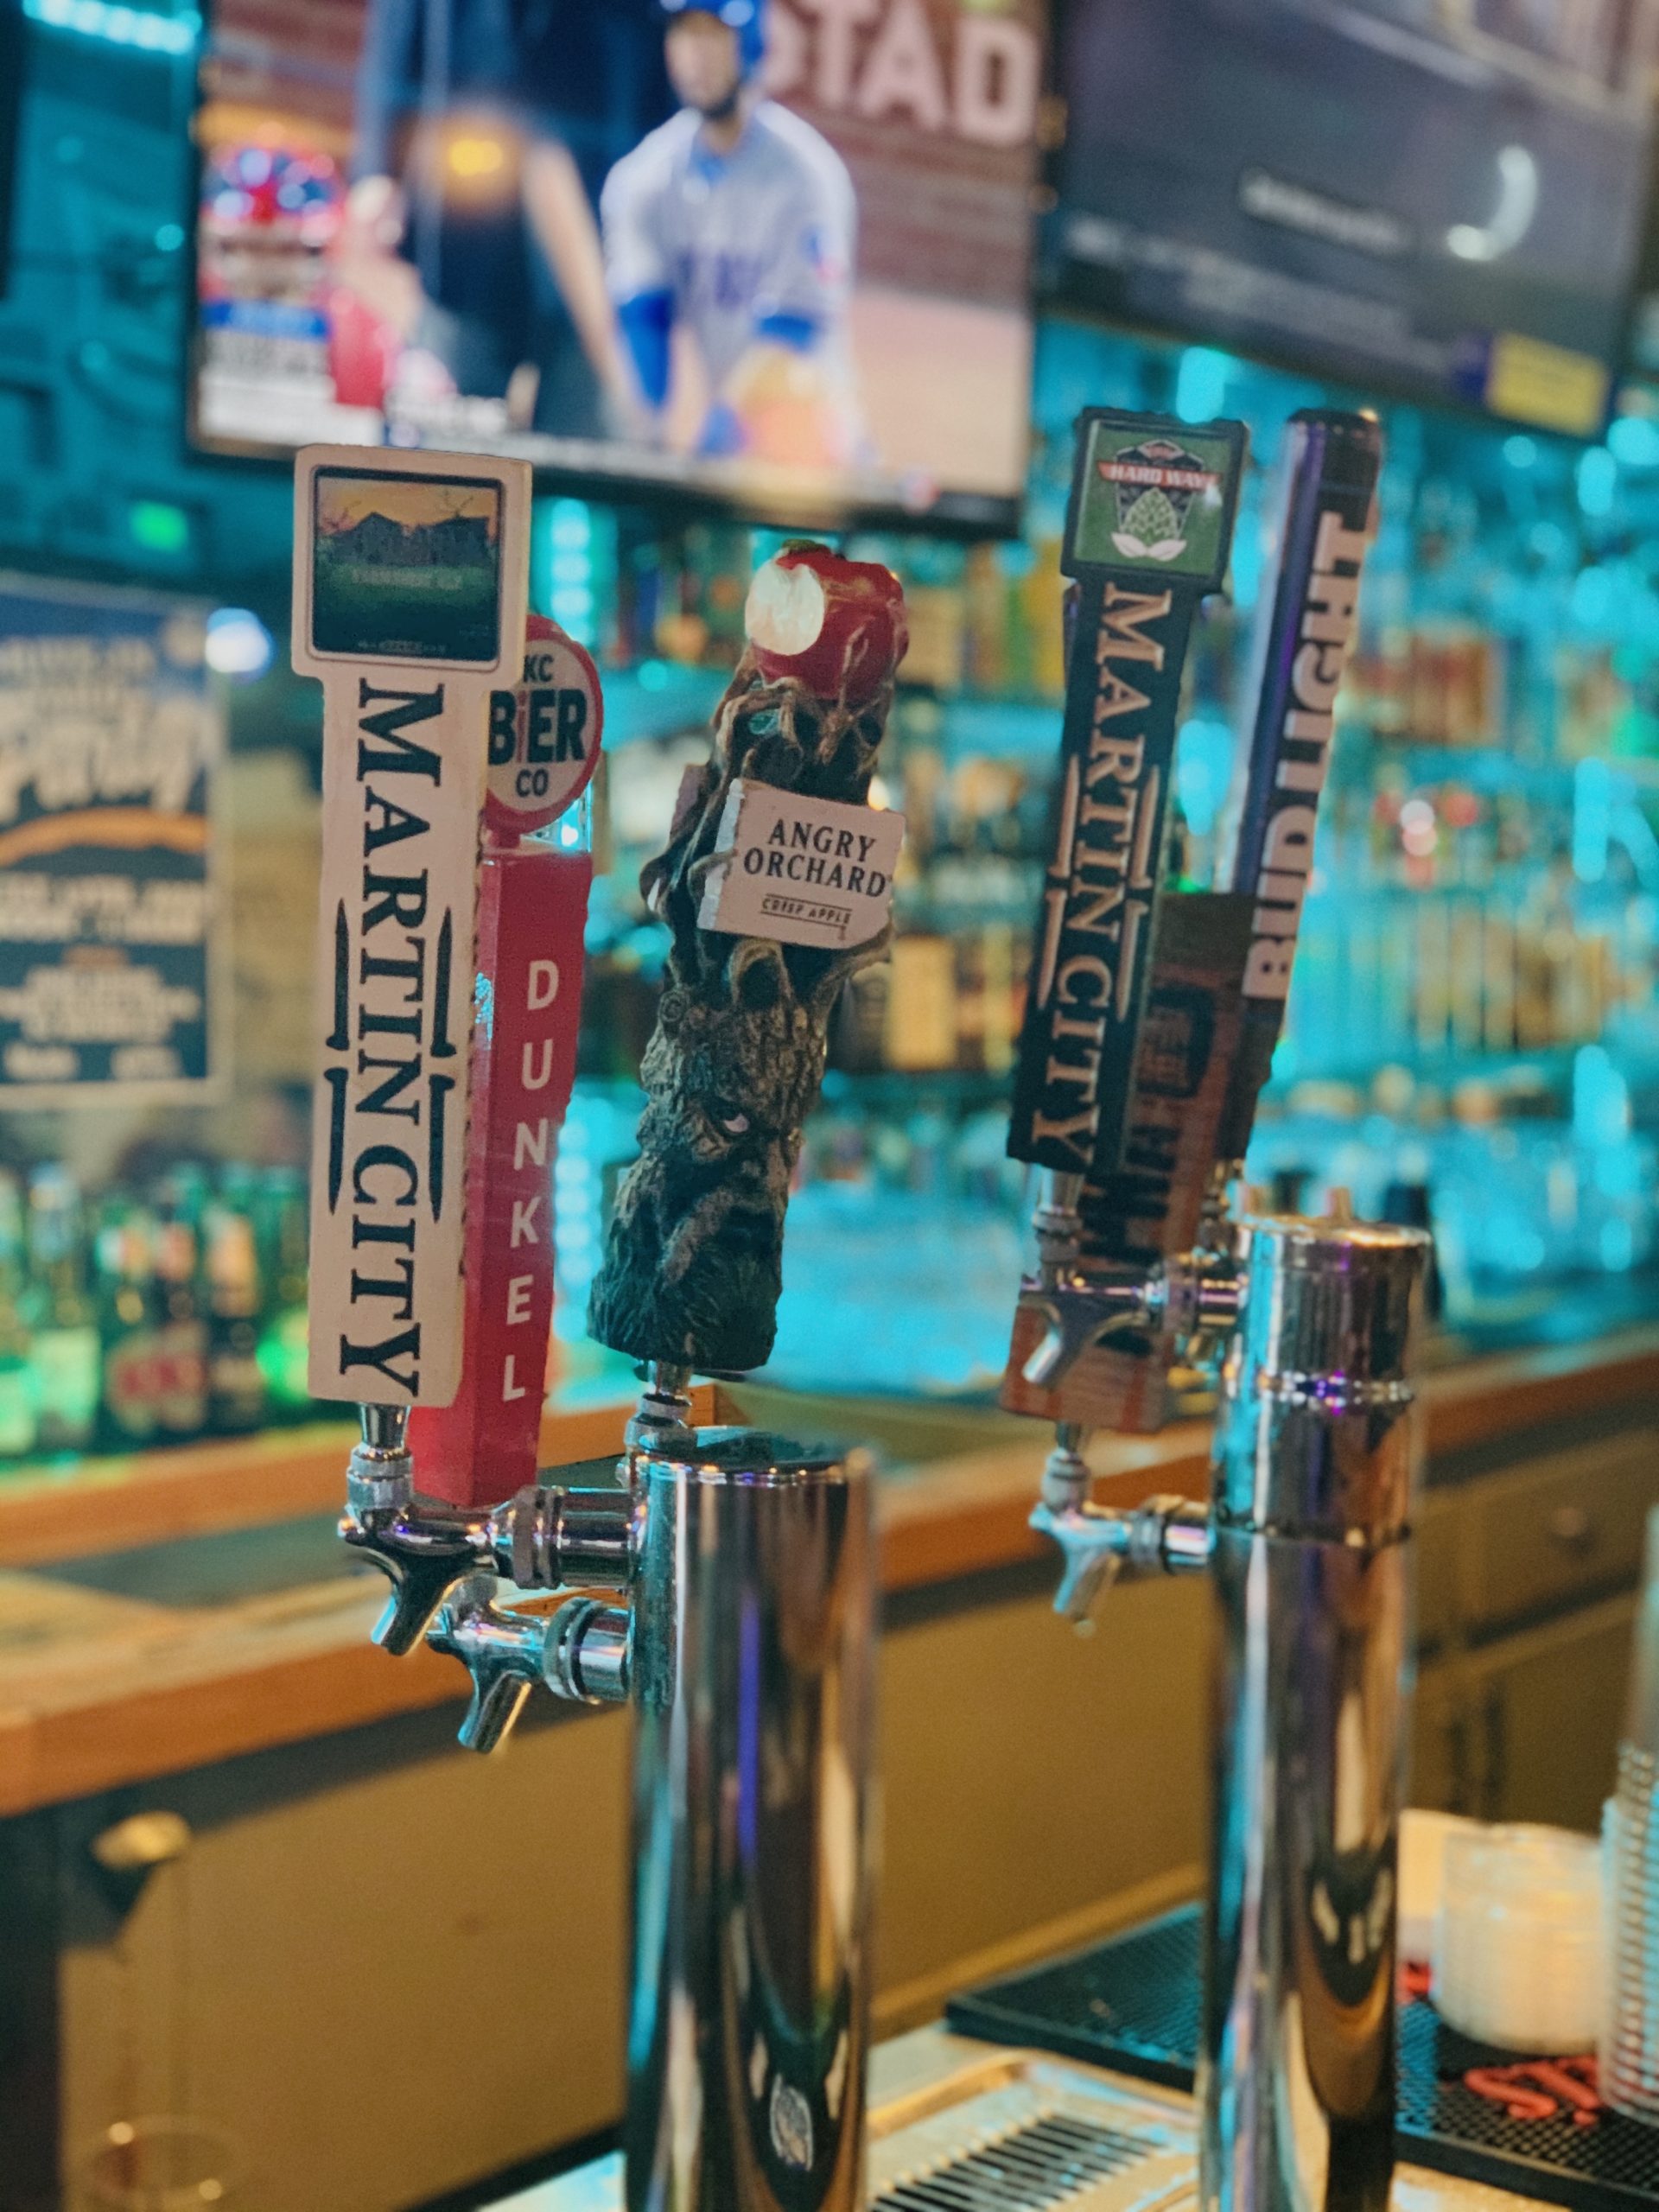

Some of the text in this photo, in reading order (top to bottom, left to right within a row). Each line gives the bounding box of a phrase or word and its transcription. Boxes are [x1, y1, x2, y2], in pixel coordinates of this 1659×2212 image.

[1110, 463, 1162, 484] HARD
[524, 654, 554, 683] KC
[1242, 511, 1368, 1001] BUD LIGHT
[516, 768, 549, 798] CO
[768, 818, 876, 862] ANGRY
[744, 847, 887, 898] ORCHARD
[1032, 582, 1173, 1165] MARTIN CITY
[355, 677, 445, 1126] MARTIN
[762, 898, 851, 925] CRISP APPLE
[502, 959, 560, 1402] DUNKEL
[339, 1144, 421, 1397] CITY
